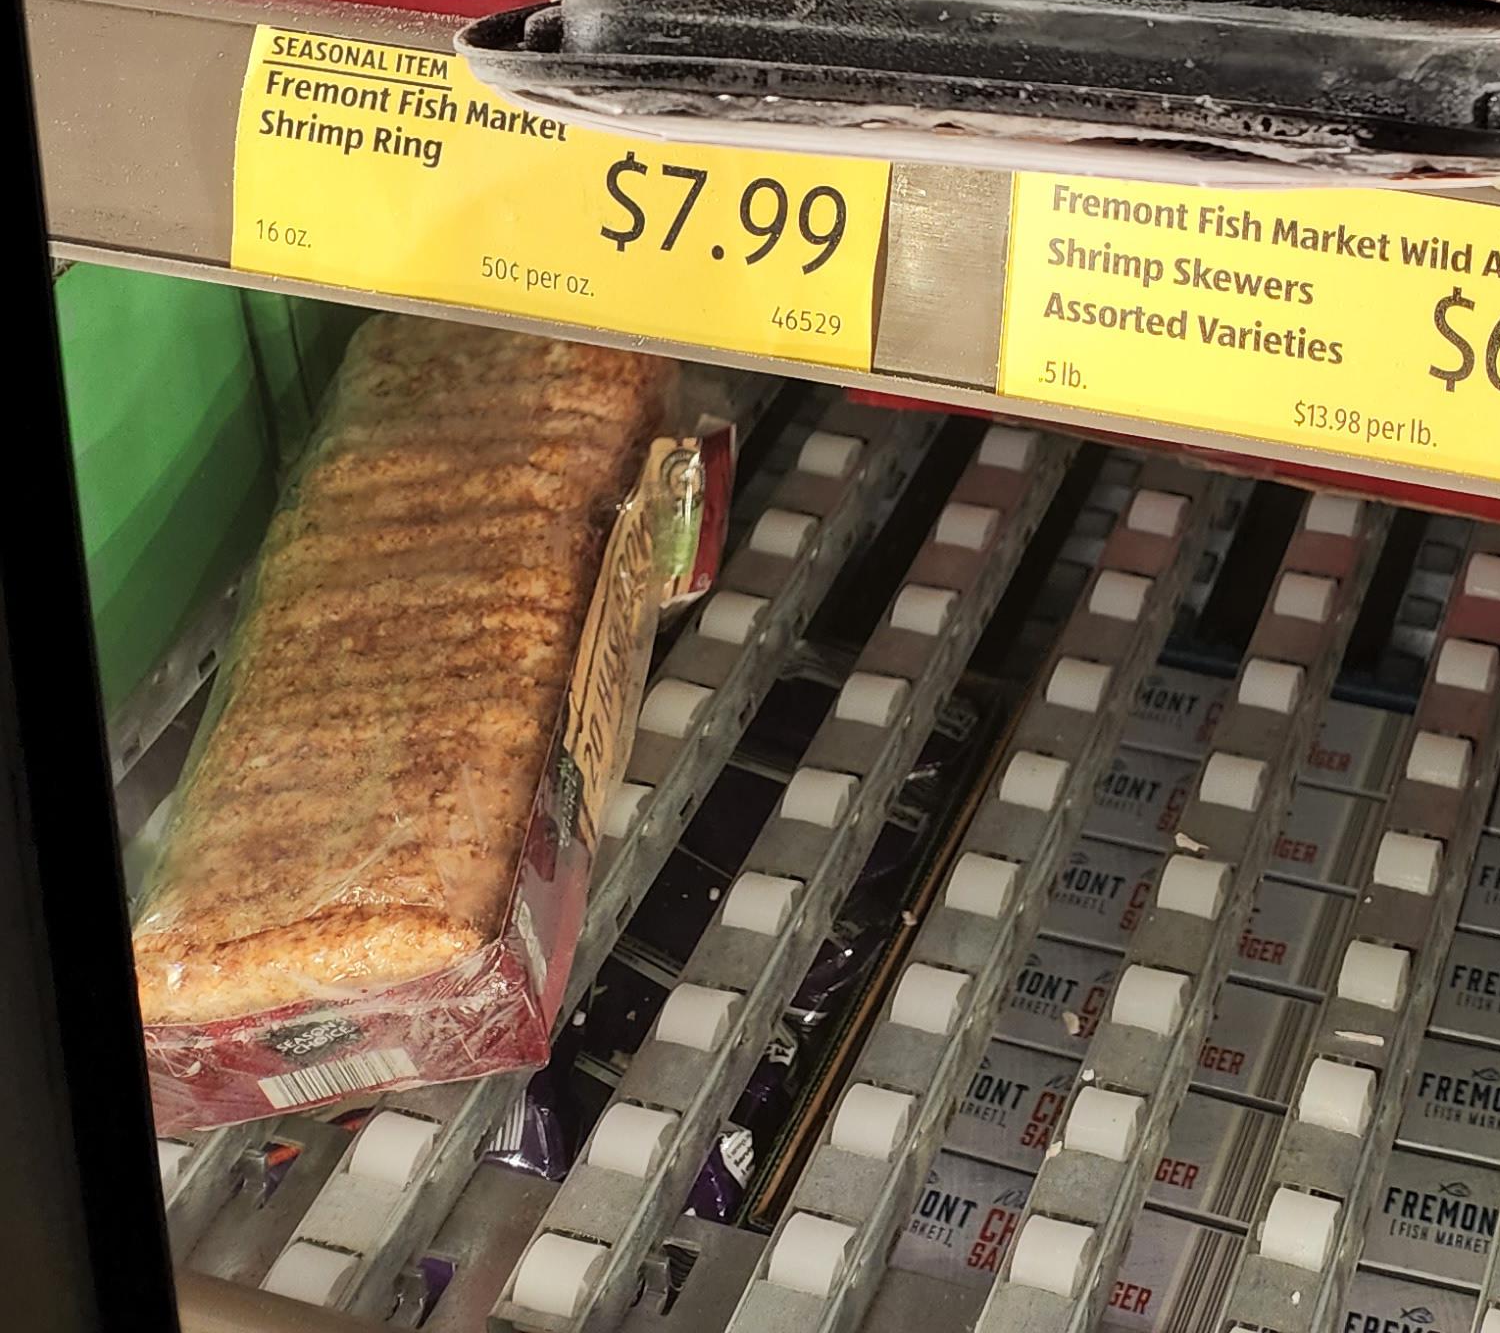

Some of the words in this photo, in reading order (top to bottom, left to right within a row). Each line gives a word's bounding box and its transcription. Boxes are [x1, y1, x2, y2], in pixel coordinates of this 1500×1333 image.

[271, 35, 388, 71] SEASONAL
[397, 52, 449, 80] ITEM
[265, 69, 391, 113] Fremont
[398, 88, 458, 123] Fish
[465, 100, 568, 142] Market
[259, 109, 364, 155] Shrimp
[373, 126, 443, 168] Ring
[255, 219, 279, 242] 16
[285, 227, 312, 248] oz.
[600, 151, 848, 275] $7.99
[1052, 184, 1189, 231] Fremont
[1198, 204, 1263, 244] Fish
[1271, 217, 1391, 263] Market
[1400, 236, 1474, 275] Wild
[481, 254, 520, 283] 50¢
[526, 265, 562, 291] per
[566, 273, 595, 297] oz.
[1047, 237, 1164, 288] Shrimp
[1173, 257, 1315, 306] Skewers
[771, 305, 842, 336] 46529
[1043, 291, 1188, 341] Assorted
[1197, 314, 1344, 365] Varieties
[1061, 361, 1088, 390] lb.
[1294, 399, 1362, 434] $13.98
[1366, 416, 1406, 444] per
[1410, 418, 1438, 448] lb.
[1382, 1185, 1497, 1235] FREMON
